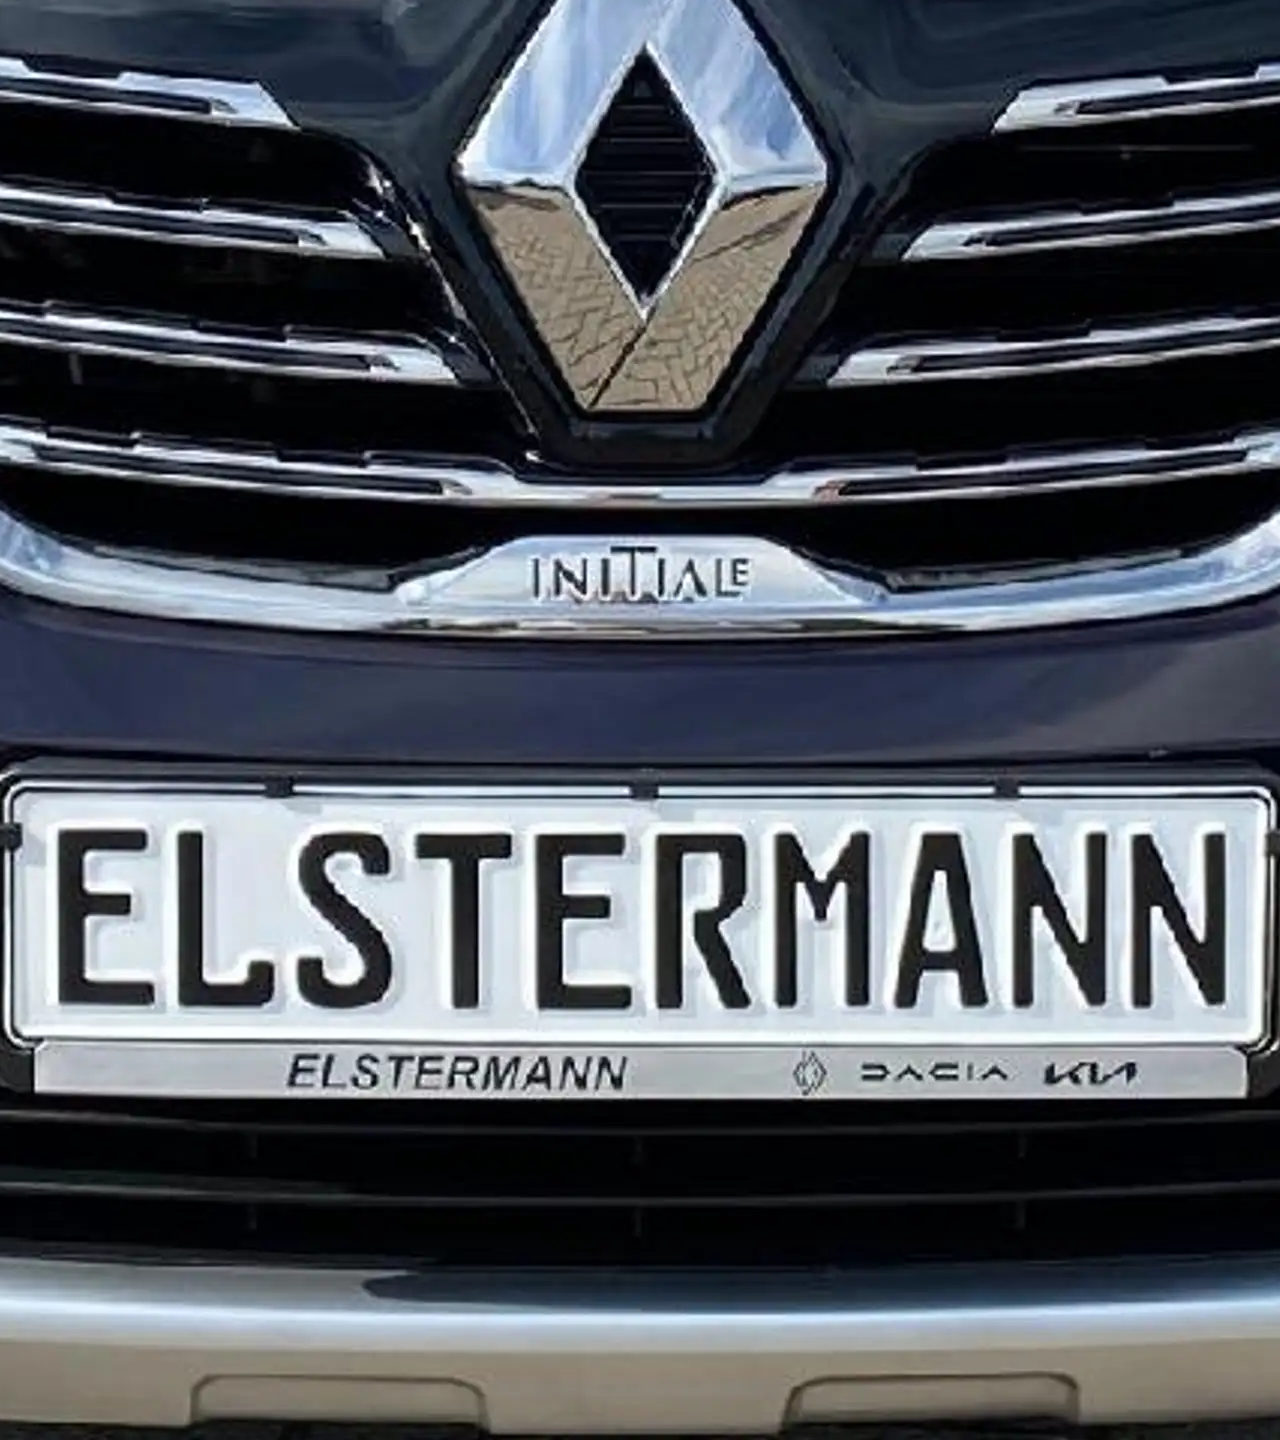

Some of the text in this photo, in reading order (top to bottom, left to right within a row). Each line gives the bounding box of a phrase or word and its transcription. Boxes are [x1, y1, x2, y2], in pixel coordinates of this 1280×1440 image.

[532, 545, 750, 598] INITIALE
[57, 828, 1227, 1010] ELSTERMANN
[287, 1053, 627, 1091] ELSTERMANN
